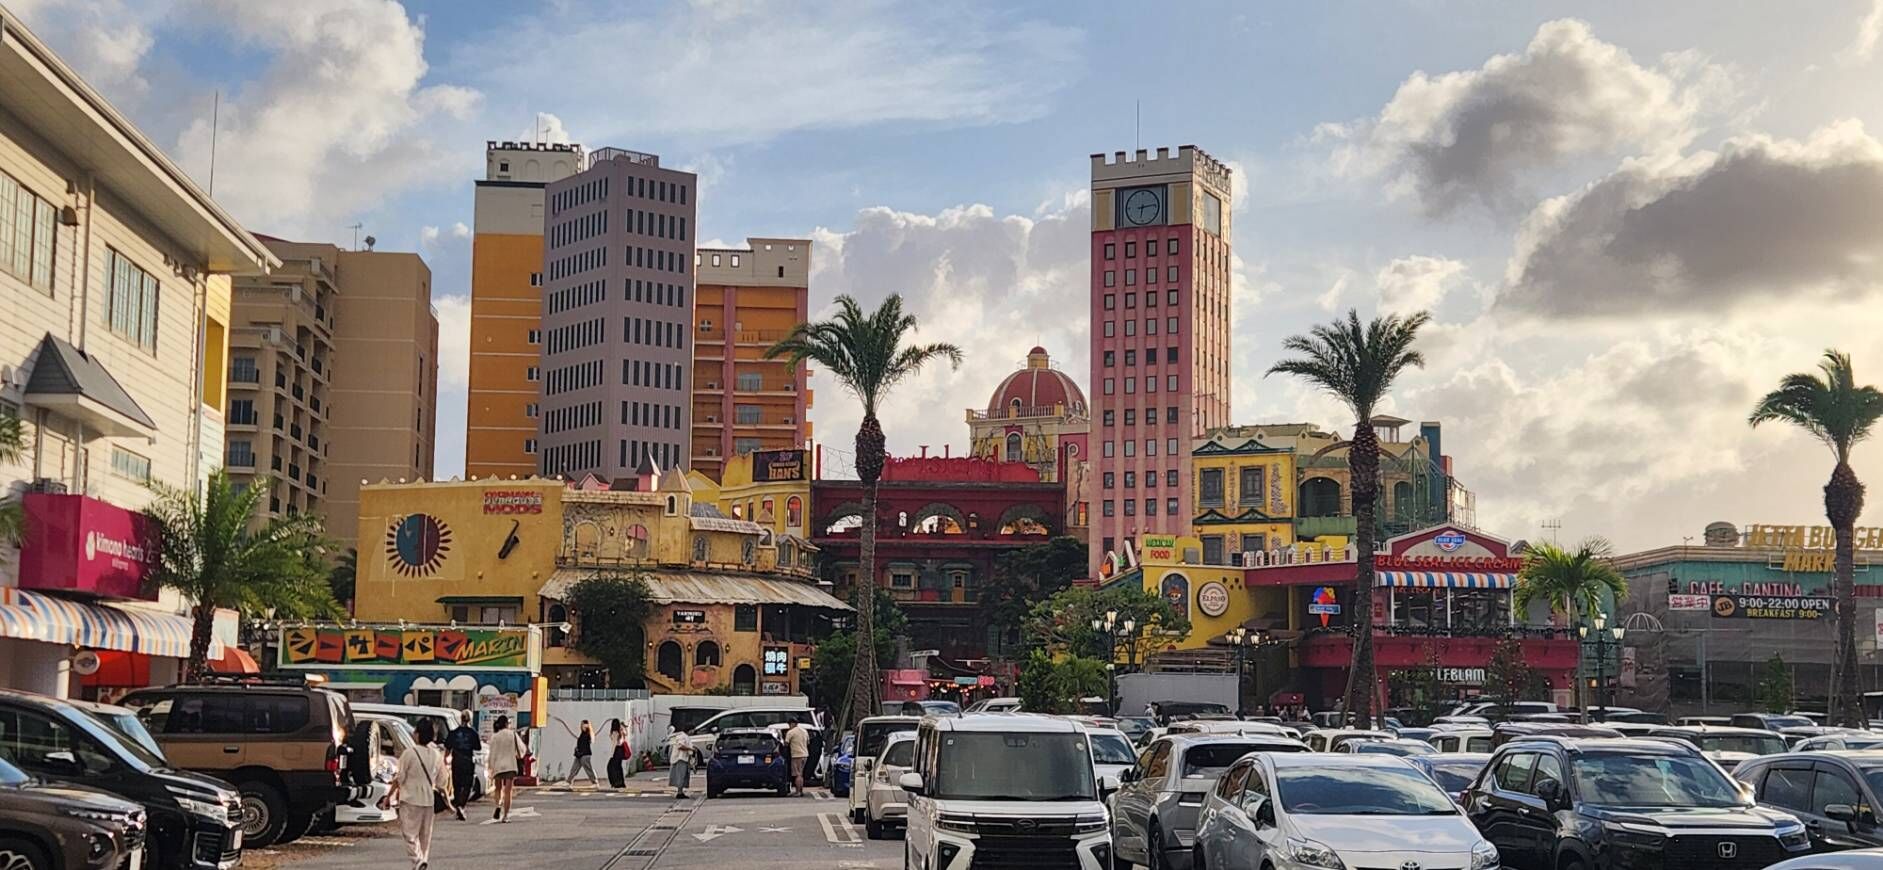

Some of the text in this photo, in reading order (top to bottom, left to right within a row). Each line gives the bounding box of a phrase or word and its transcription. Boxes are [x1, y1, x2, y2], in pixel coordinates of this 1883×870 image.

[919, 444, 999, 477] Island
[483, 504, 543, 515] MODS
[1808, 526, 1883, 549] BUGE
[96, 531, 122, 557] kimono
[123, 539, 144, 563] hearts
[1151, 550, 1170, 560] FOOD
[1378, 555, 1521, 570] BLUE SEAL ICE CREAM
[1690, 582, 1723, 595] CAFE
[1743, 582, 1802, 597] CANTINA
[1718, 601, 1733, 611] JB
[1739, 597, 1830, 610] 9:00-22:00 OPEN
[1747, 609, 1795, 618] BREAKFAST
[455, 635, 526, 661] MARIN
